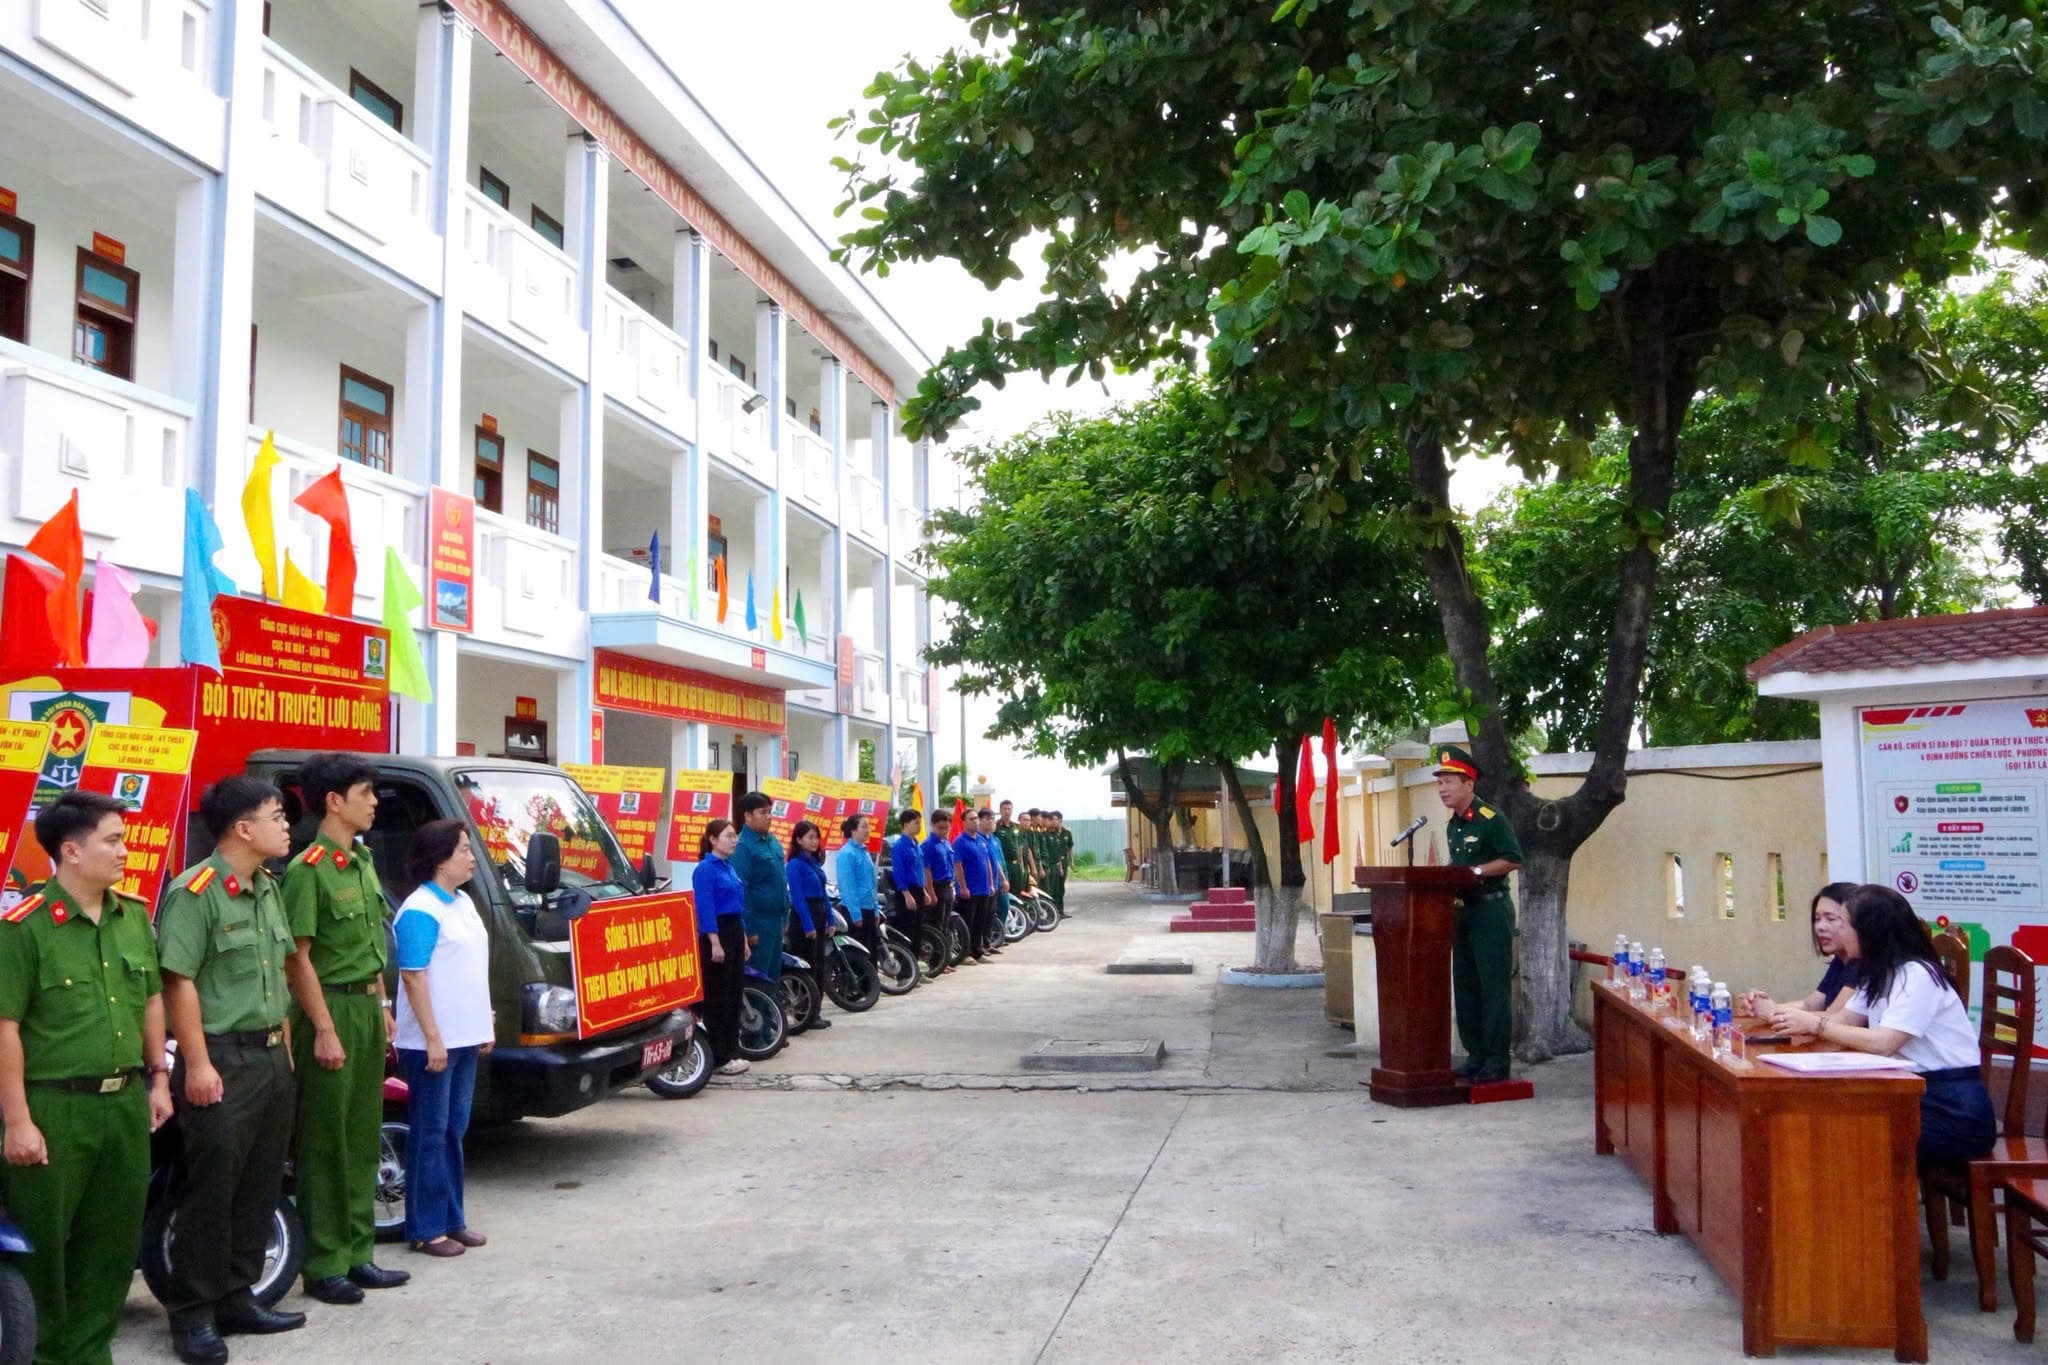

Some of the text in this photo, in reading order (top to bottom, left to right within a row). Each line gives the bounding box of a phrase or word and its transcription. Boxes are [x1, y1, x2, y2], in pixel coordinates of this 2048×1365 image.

[203, 677, 228, 725] ĐỘI
[232, 682, 275, 723] TUYÊN
[328, 695, 350, 729] LƯU
[352, 694, 381, 736] ĐỘNG
[605, 912, 672, 953] SỐNG VÀ LÀM VIỆC
[584, 948, 694, 1004] THEO HIẾN PHÁP VÀ PHÁP LUẬT
